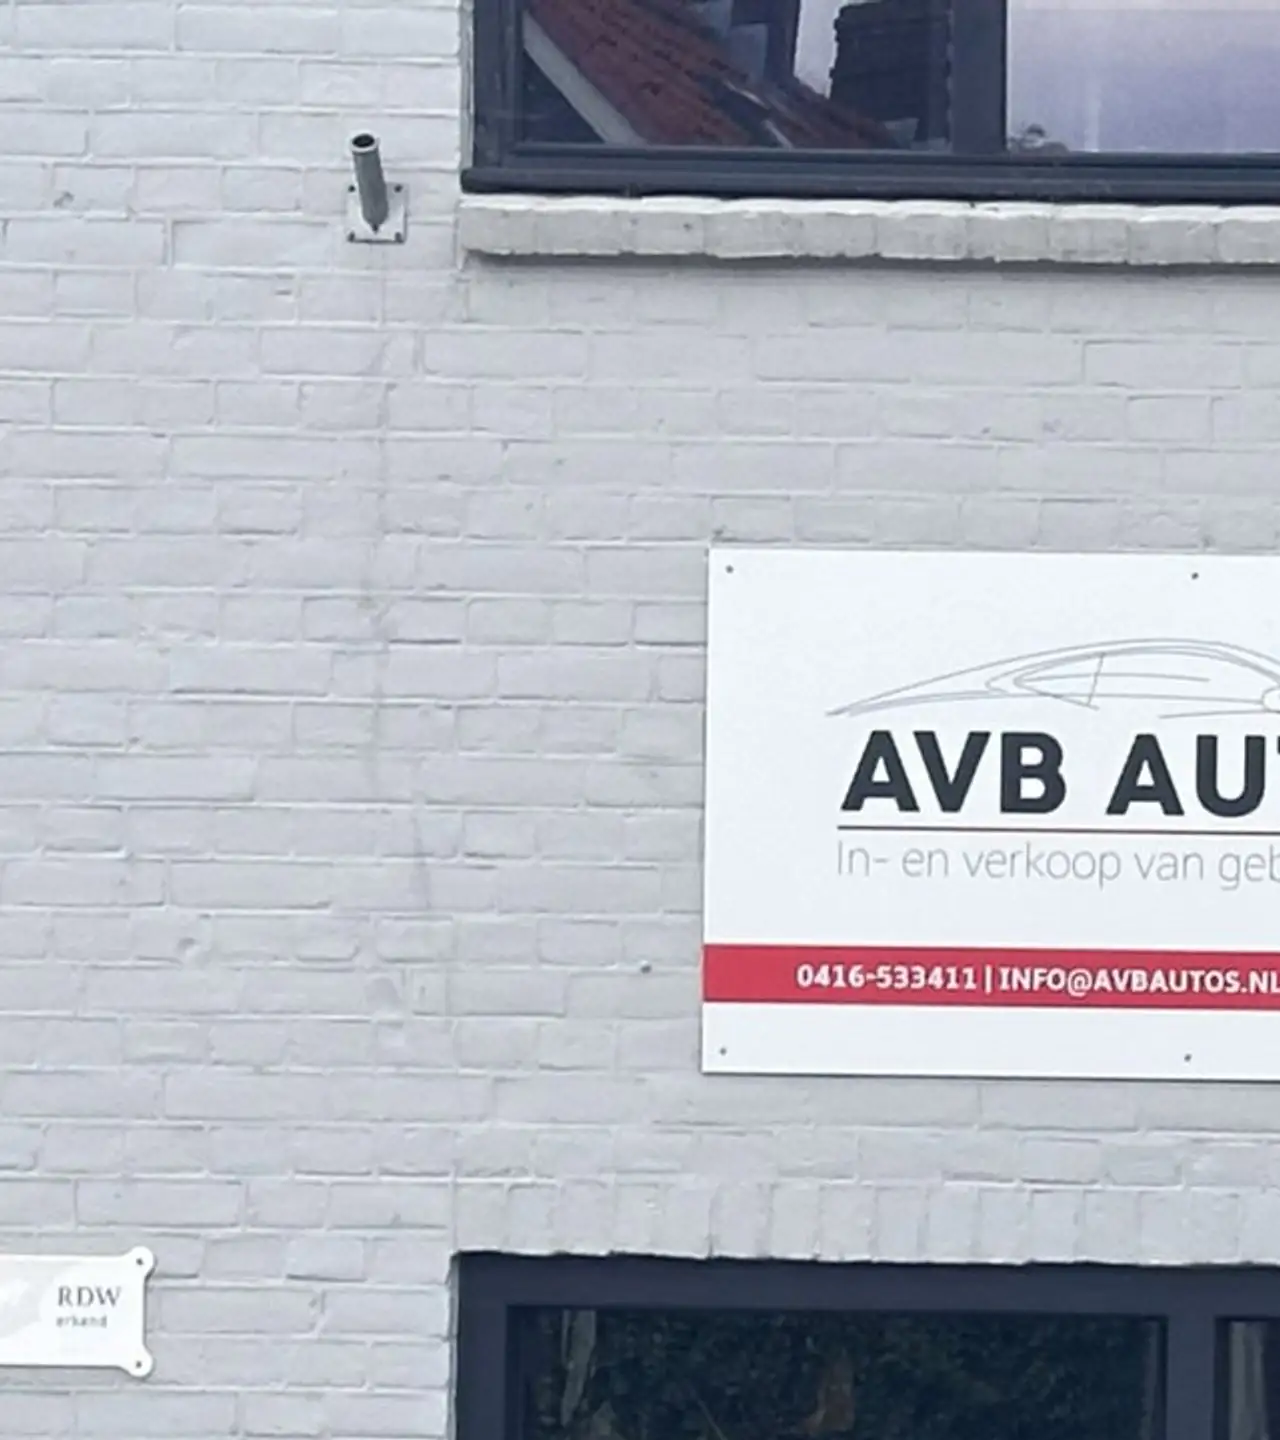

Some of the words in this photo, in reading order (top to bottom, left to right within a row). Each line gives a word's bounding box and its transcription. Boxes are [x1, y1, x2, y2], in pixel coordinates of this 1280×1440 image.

[840, 729, 1067, 815] AVB
[837, 840, 888, 876] In-
[901, 849, 949, 877] en
[963, 842, 1122, 889] verkoop
[1134, 852, 1204, 882] van
[797, 963, 977, 991] 0416-533411
[57, 1285, 121, 1308] RDW
